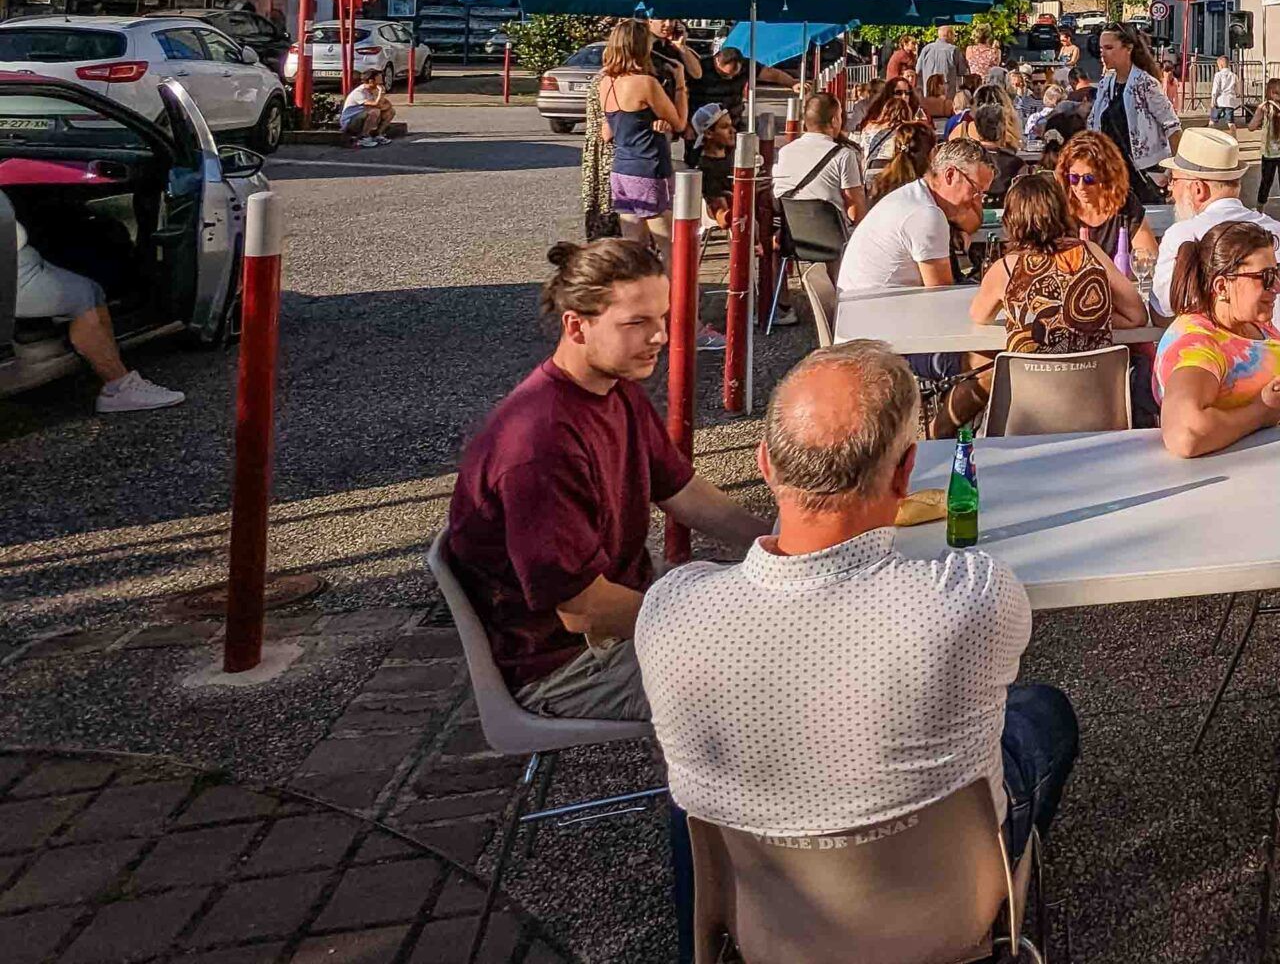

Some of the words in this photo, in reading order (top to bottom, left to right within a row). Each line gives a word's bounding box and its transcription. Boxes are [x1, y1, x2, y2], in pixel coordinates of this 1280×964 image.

[1153, 6, 1165, 14] 30
[1024, 363, 1051, 372] VILLE
[819, 837, 848, 849] DE
[855, 814, 919, 845] LINAS
